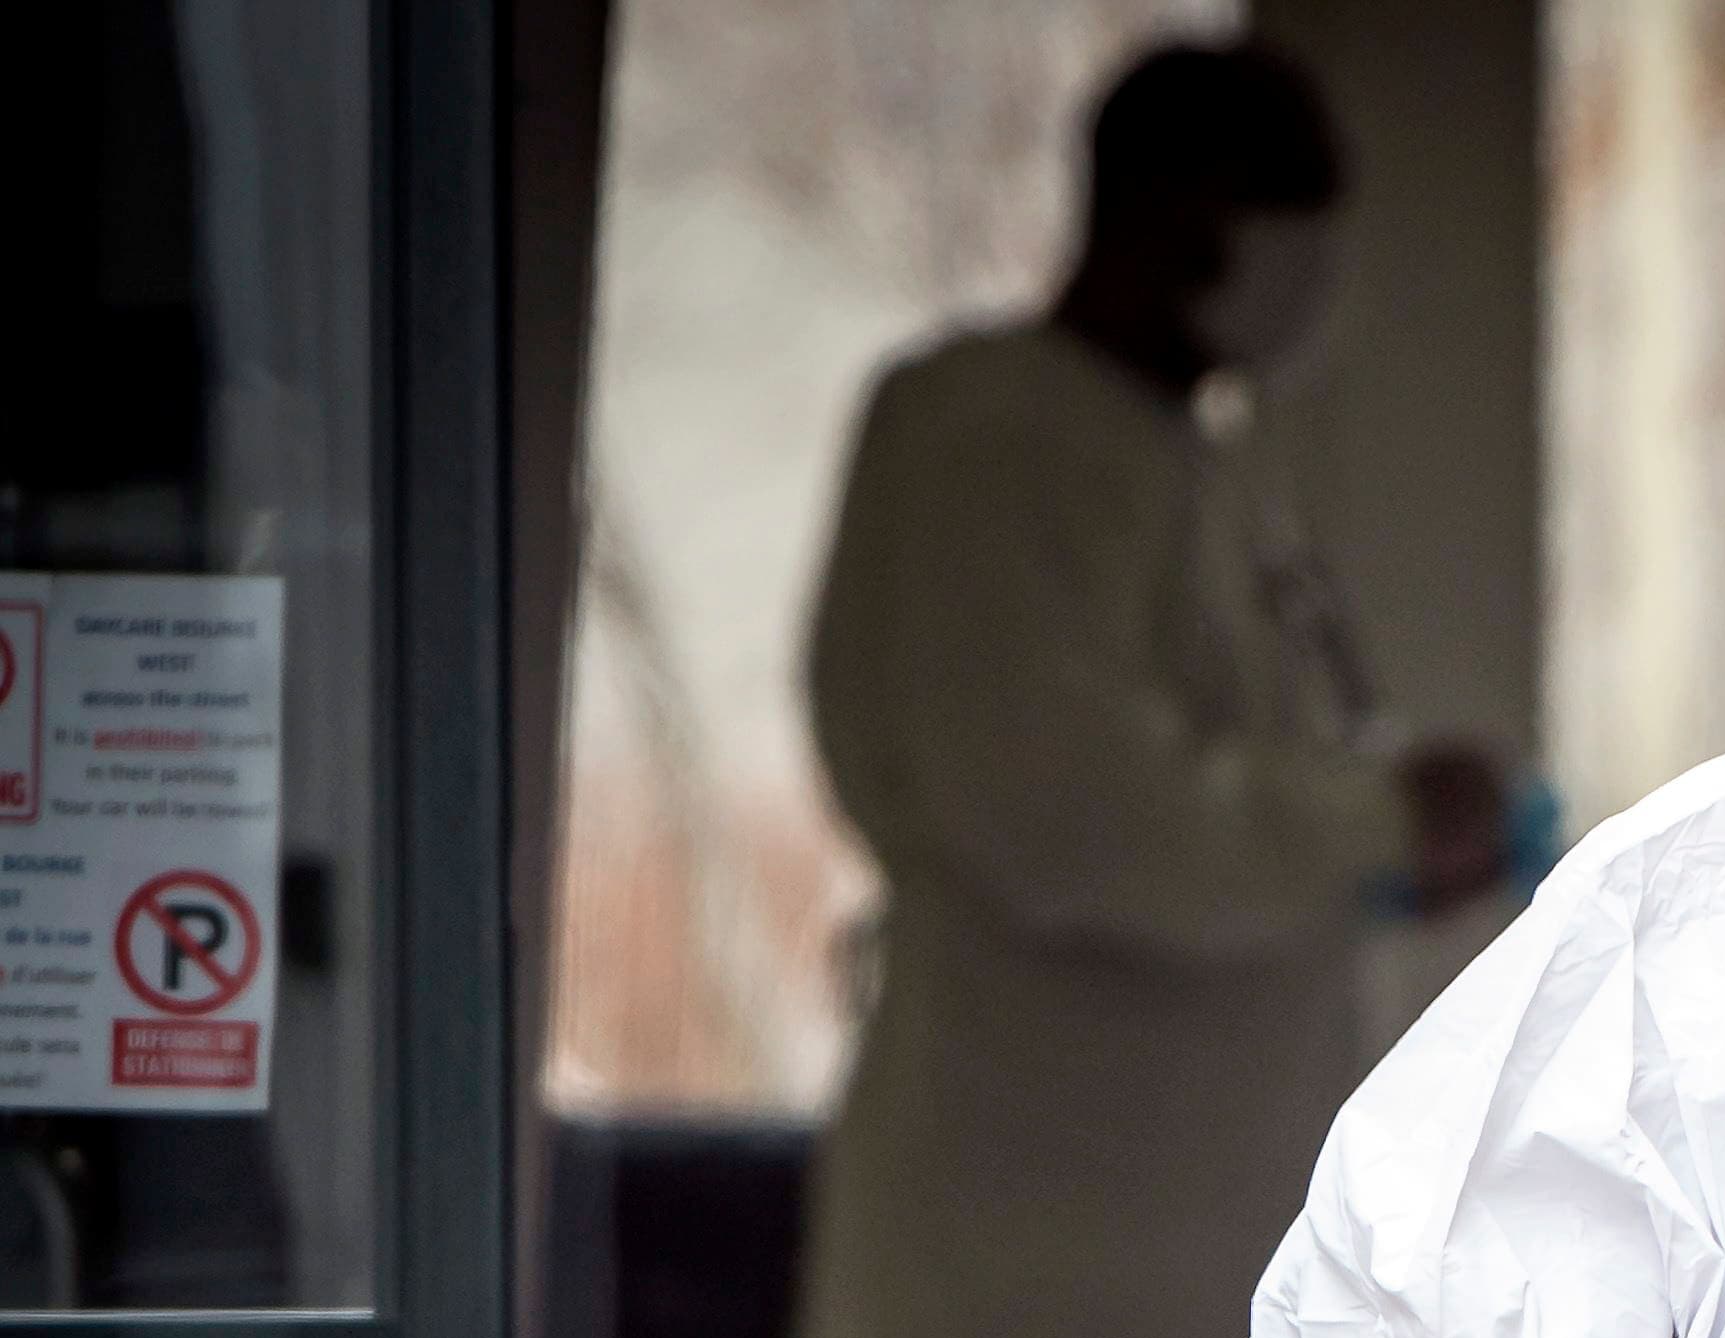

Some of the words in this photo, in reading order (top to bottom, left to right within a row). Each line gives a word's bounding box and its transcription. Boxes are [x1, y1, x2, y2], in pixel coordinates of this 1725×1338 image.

[75, 617, 162, 635] DAYCARE
[136, 654, 193, 672] WEST
[149, 688, 183, 707] the
